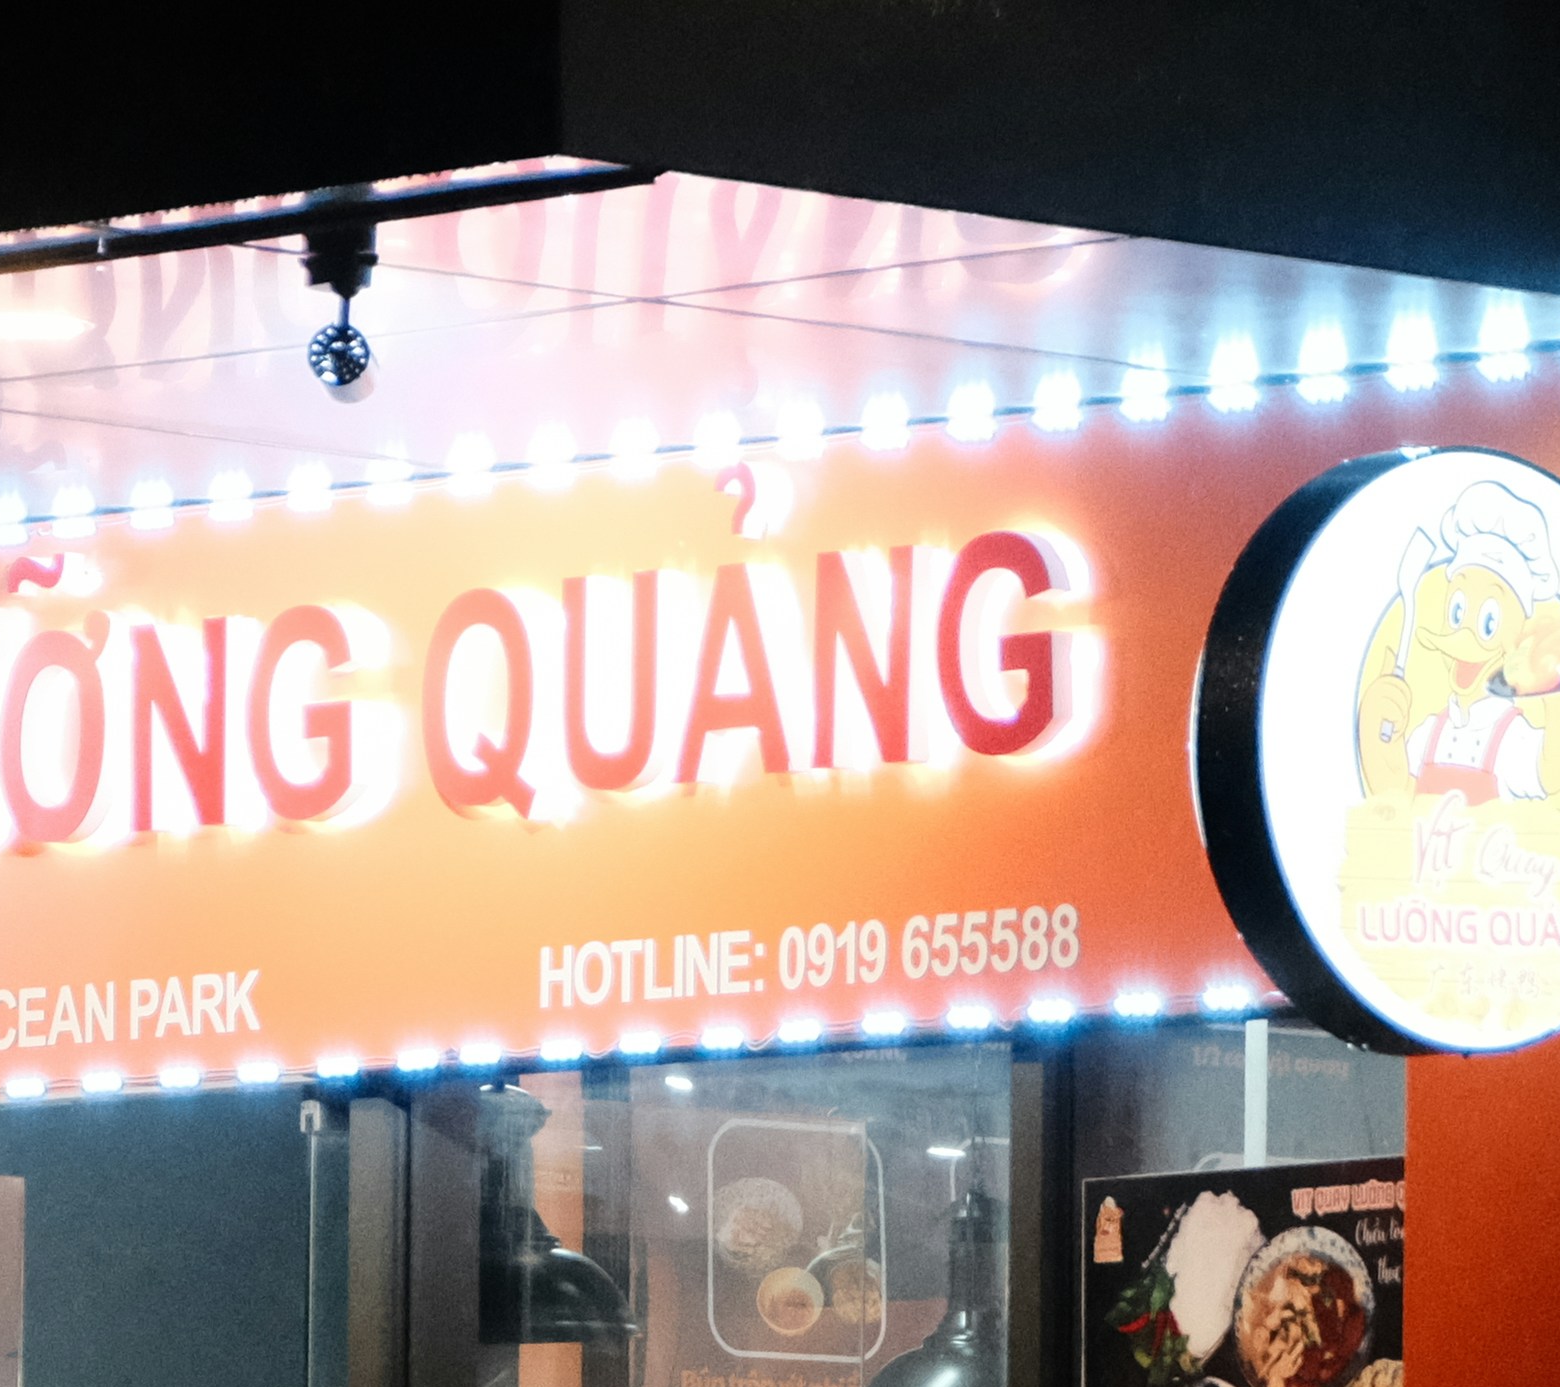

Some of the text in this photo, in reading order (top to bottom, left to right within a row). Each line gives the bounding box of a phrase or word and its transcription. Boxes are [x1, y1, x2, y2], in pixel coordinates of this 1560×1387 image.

[421, 462, 1076, 831] QUẢNG
[129, 970, 262, 1041] PARK
[538, 904, 1080, 1010] HOTLINE: 0919 655588
